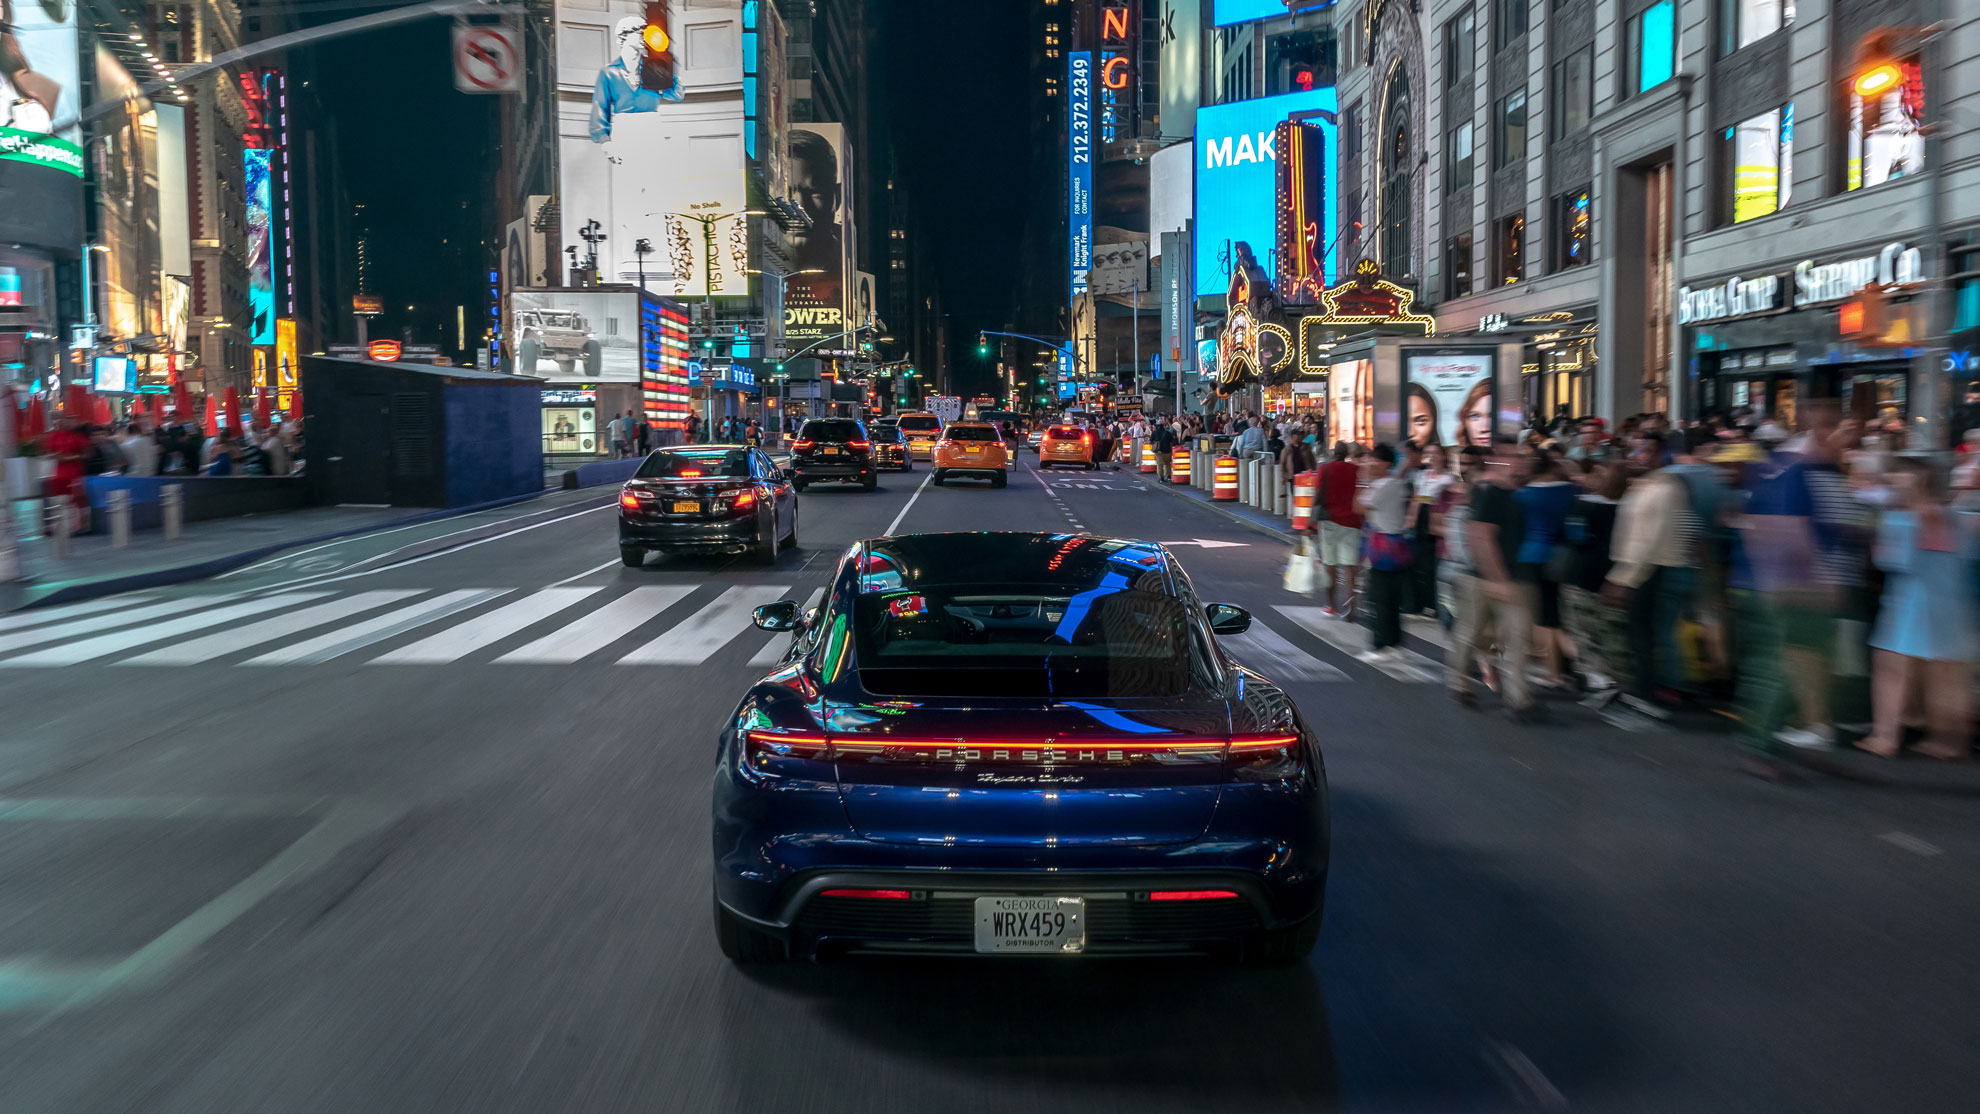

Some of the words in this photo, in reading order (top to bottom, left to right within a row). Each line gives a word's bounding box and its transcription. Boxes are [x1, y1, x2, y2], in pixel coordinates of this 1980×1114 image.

[1073, 59, 1088, 163] 212.372.2349
[702, 201, 721, 209] Shells
[1080, 224, 1088, 243] Frank
[1080, 245, 1089, 267] Knight
[1050, 481, 1148, 492] ONLY
[936, 749, 1124, 761] PORSCHE
[1038, 774, 1085, 783] Turbo
[1001, 900, 1060, 910] GEORGIA
[993, 912, 1066, 937] WRX459
